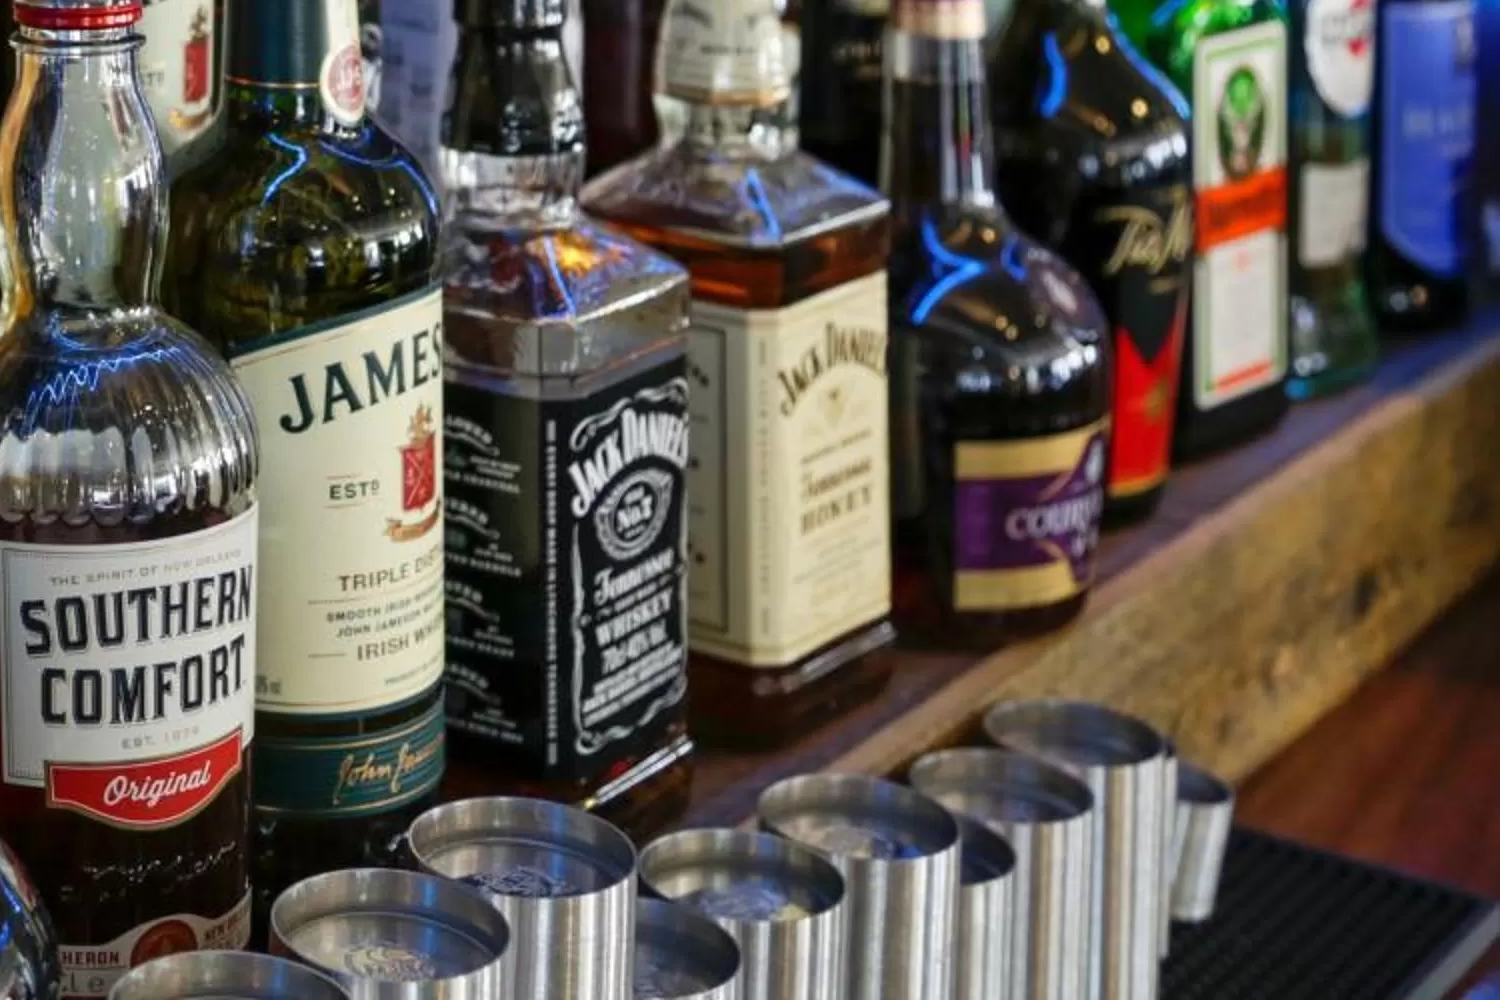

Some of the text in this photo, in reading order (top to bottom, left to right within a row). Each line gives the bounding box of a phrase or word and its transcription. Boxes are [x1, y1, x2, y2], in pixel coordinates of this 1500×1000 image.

[778, 346, 822, 417] JACK
[568, 427, 625, 518] JACK
[50, 574, 82, 587] THE
[139, 565, 158, 579] OF
[339, 562, 408, 593] TRIPLE
[19, 563, 254, 657] SOUTHERN
[596, 585, 674, 646] WHISKEY
[357, 635, 409, 661] IRISH
[40, 632, 248, 726] COMFORT
[103, 759, 212, 809] Original
[61, 949, 121, 968] HERON
